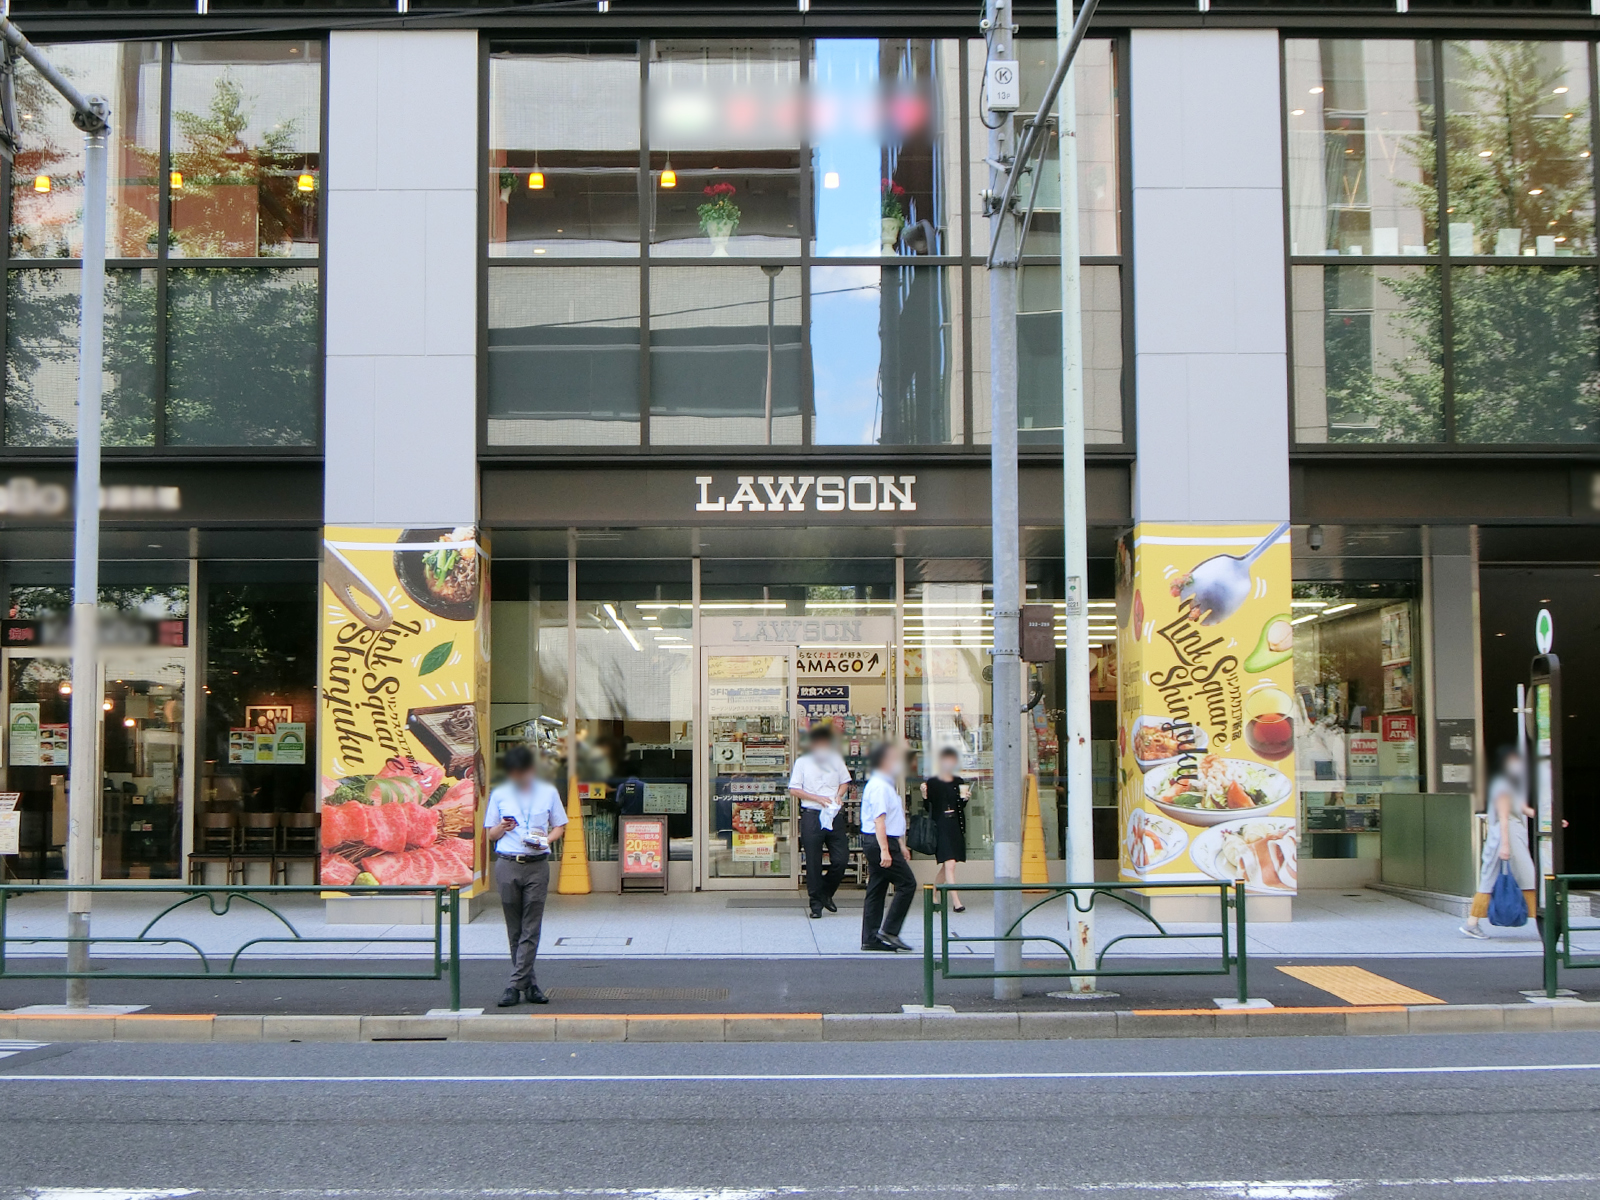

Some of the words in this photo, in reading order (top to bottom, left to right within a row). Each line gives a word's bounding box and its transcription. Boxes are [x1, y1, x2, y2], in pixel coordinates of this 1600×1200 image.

[695, 475, 917, 511] LAWSON
[732, 620, 862, 642] LAWSON
[323, 622, 374, 767] Shinjuku
[800, 687, 844, 696] 飲食スペース
[1190, 655, 1238, 747] Square
[361, 673, 405, 772] Square
[1150, 665, 1208, 787] Shinjuku
[740, 810, 766, 822] 野菜
[626, 840, 643, 851] 20
